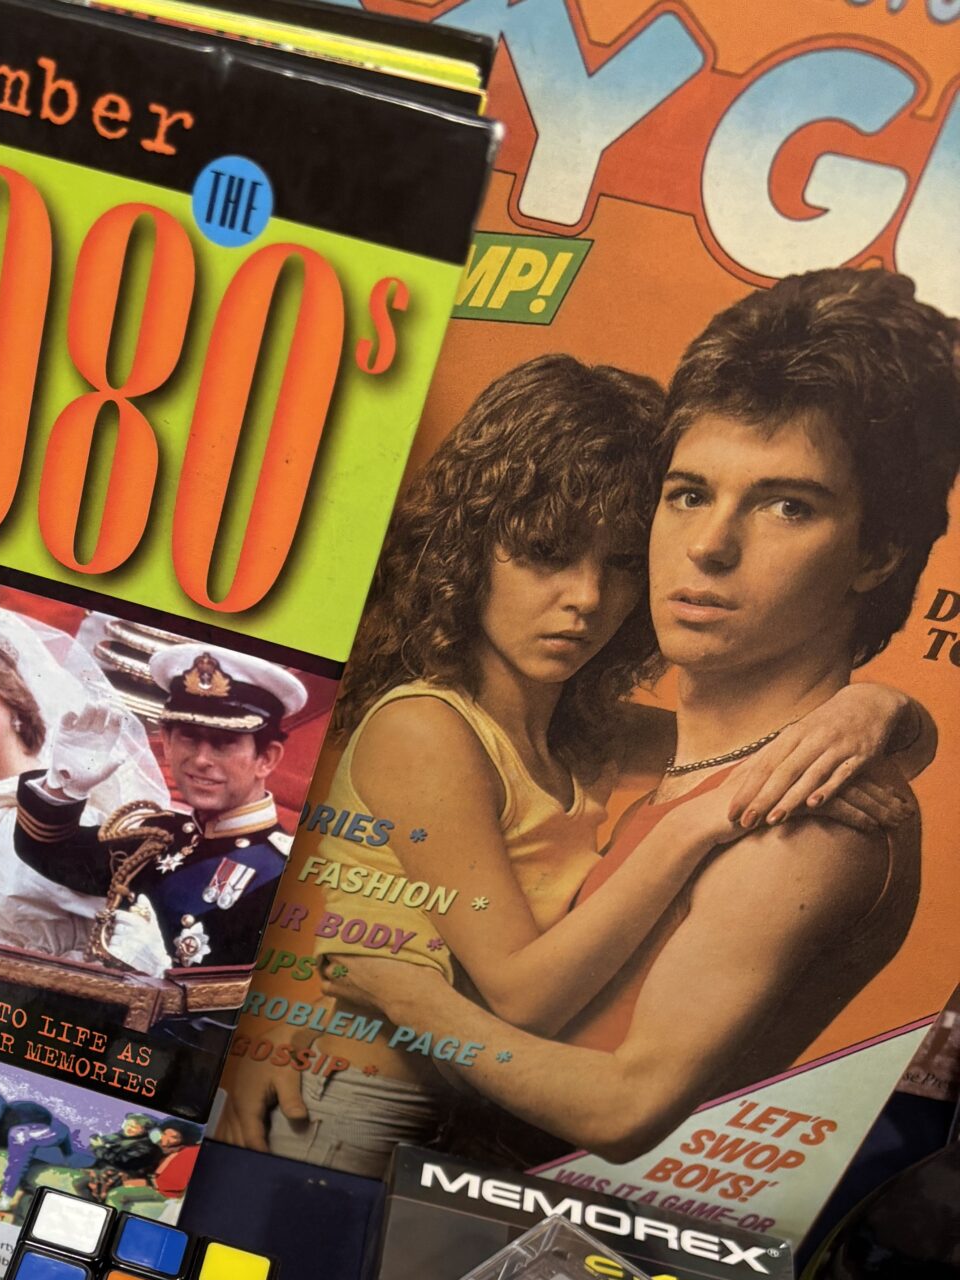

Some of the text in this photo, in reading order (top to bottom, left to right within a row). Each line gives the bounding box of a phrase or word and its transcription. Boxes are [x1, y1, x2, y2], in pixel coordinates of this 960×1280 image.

[203, 168, 266, 237] THE
[297, 855, 459, 916] FASHION
[314, 911, 417, 955] BODY
[37, 1015, 108, 1053] LIFE
[117, 1042, 152, 1067] AS
[231, 1034, 351, 1078] GOSSIP
[387, 1025, 485, 1067] PAGE
[24, 1040, 158, 1098] MEMORIES
[680, 1128, 807, 1174] SWOP
[554, 1168, 609, 1197] WAS
[613, 1182, 643, 1203] IT
[637, 1188, 659, 1207] A
[419, 1163, 771, 1275] MEMOREX
